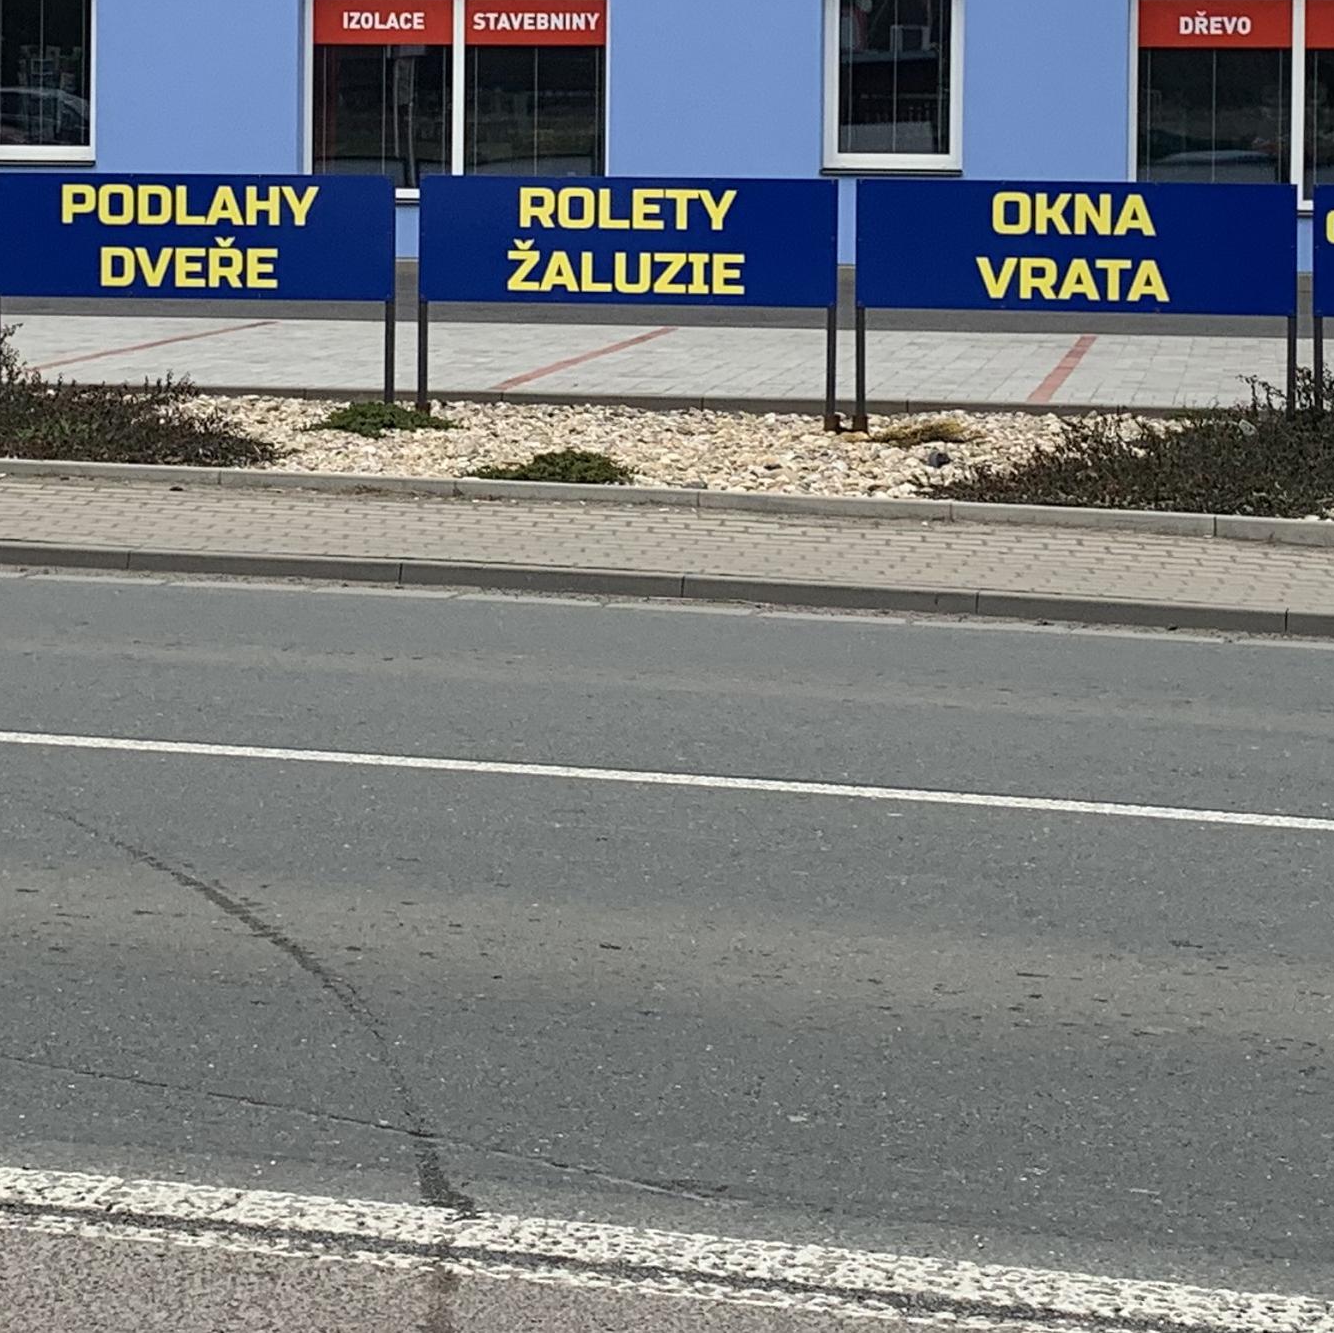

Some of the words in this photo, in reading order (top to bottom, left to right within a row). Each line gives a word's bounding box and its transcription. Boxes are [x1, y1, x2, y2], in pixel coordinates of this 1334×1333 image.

[343, 11, 425, 30] IZOLACE
[473, 12, 600, 31] STAVEBNINY
[1178, 11, 1252, 35] DŘEVO
[61, 183, 319, 226] PODLAHY
[519, 186, 736, 231] ROLETY
[992, 191, 1155, 236] OKNA
[100, 237, 279, 289] DVEŘE
[507, 240, 744, 299] ŽALUZIE
[976, 256, 1170, 302] VRATA
